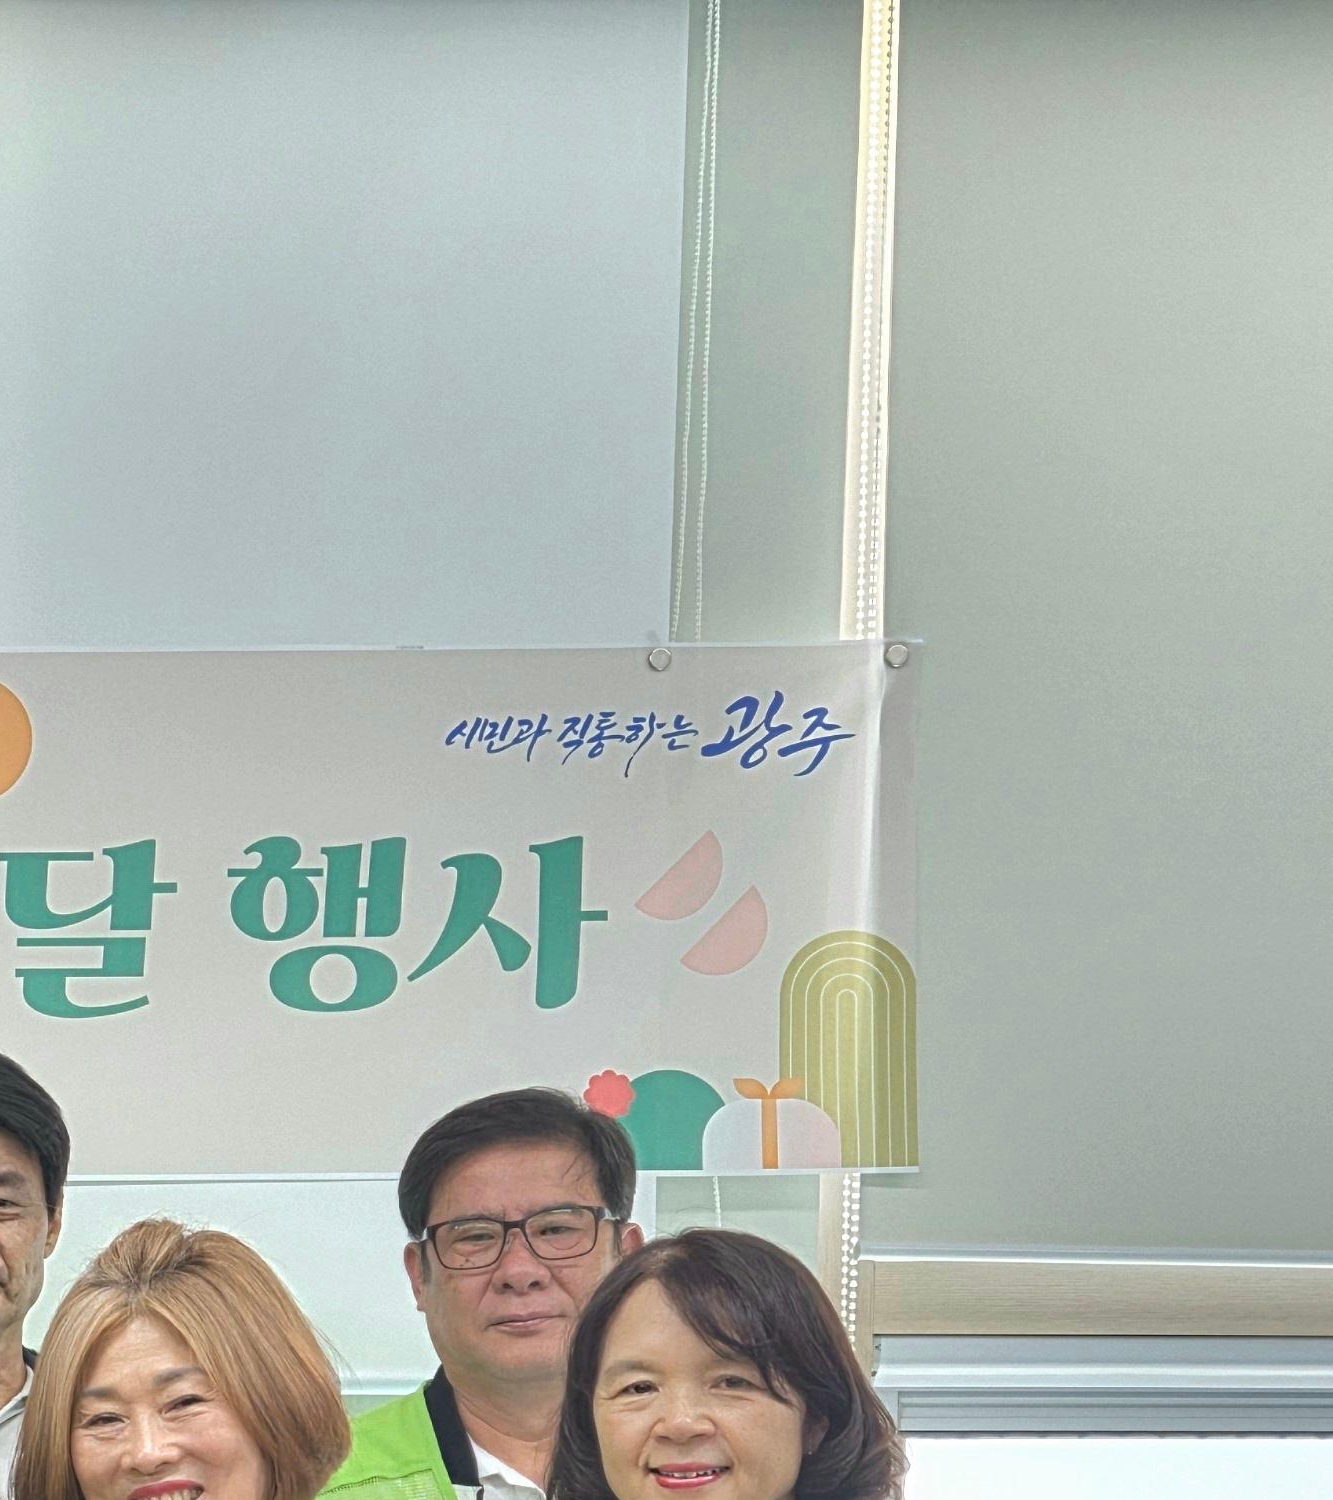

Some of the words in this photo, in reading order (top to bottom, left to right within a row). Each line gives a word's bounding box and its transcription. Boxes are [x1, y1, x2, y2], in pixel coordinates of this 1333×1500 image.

[444, 713, 552, 762] 시민과
[557, 711, 699, 777] 직통하는
[700, 690, 856, 776] 광주
[227, 834, 608, 1014] 행사
